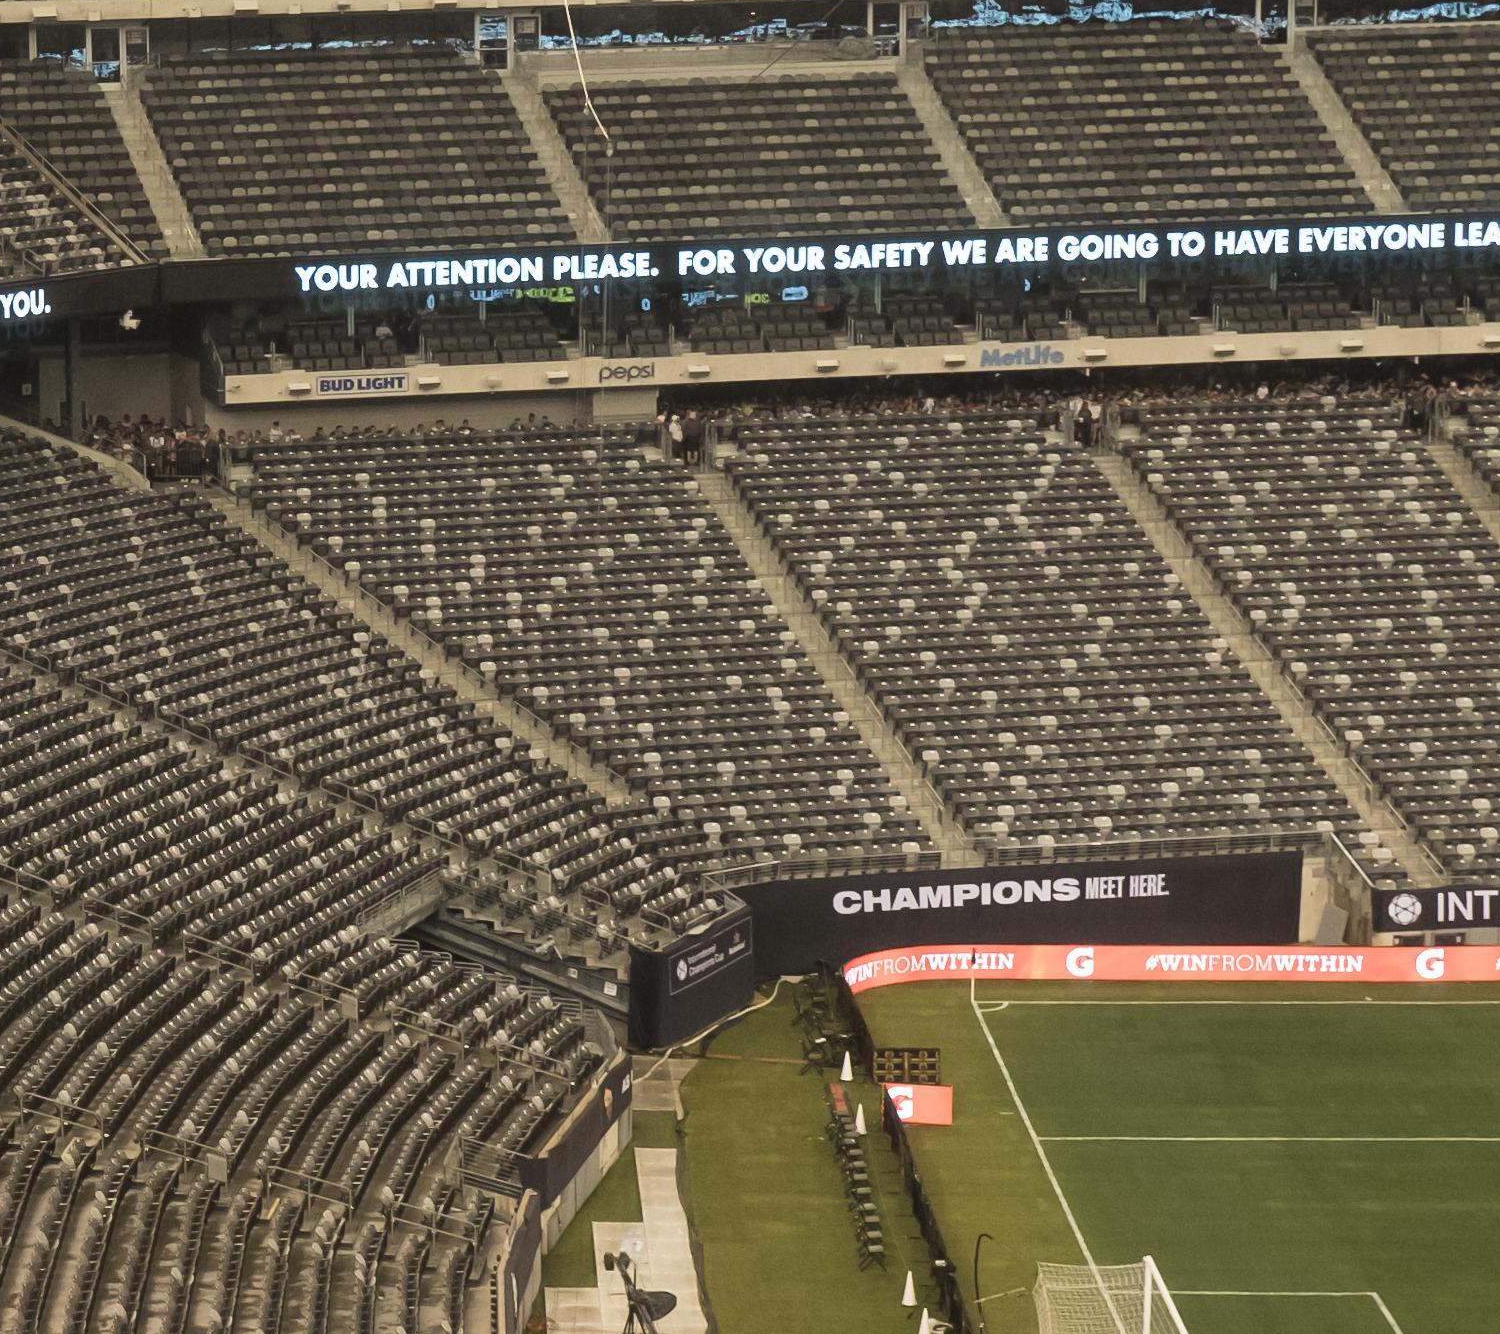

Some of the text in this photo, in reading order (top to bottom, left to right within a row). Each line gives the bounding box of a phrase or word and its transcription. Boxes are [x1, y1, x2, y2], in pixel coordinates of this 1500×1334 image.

[295, 264, 378, 291] YOUR
[387, 257, 543, 287] ATTENTION
[553, 253, 659, 280] PLEASE.
[679, 250, 736, 275] FOR
[743, 246, 825, 272] YOUR
[834, 242, 934, 269] SAFETY
[942, 240, 986, 265] WE
[995, 237, 1048, 263] ARE
[1058, 233, 1158, 260] GOING
[1167, 232, 1205, 256] TO
[1215, 229, 1289, 255] HAVE
[1299, 223, 1445, 252] EVERYONE
[0, 289, 51, 318] YOU.
[981, 345, 1064, 367] MetLife
[320, 376, 405, 392] BUD LIGHT
[599, 363, 655, 383] pepsi
[833, 873, 1169, 914] CHAMPIONS MEET HERE.
[1066, 947, 1094, 977] G
[1145, 954, 1363, 972] #WINFROMWITHIN
